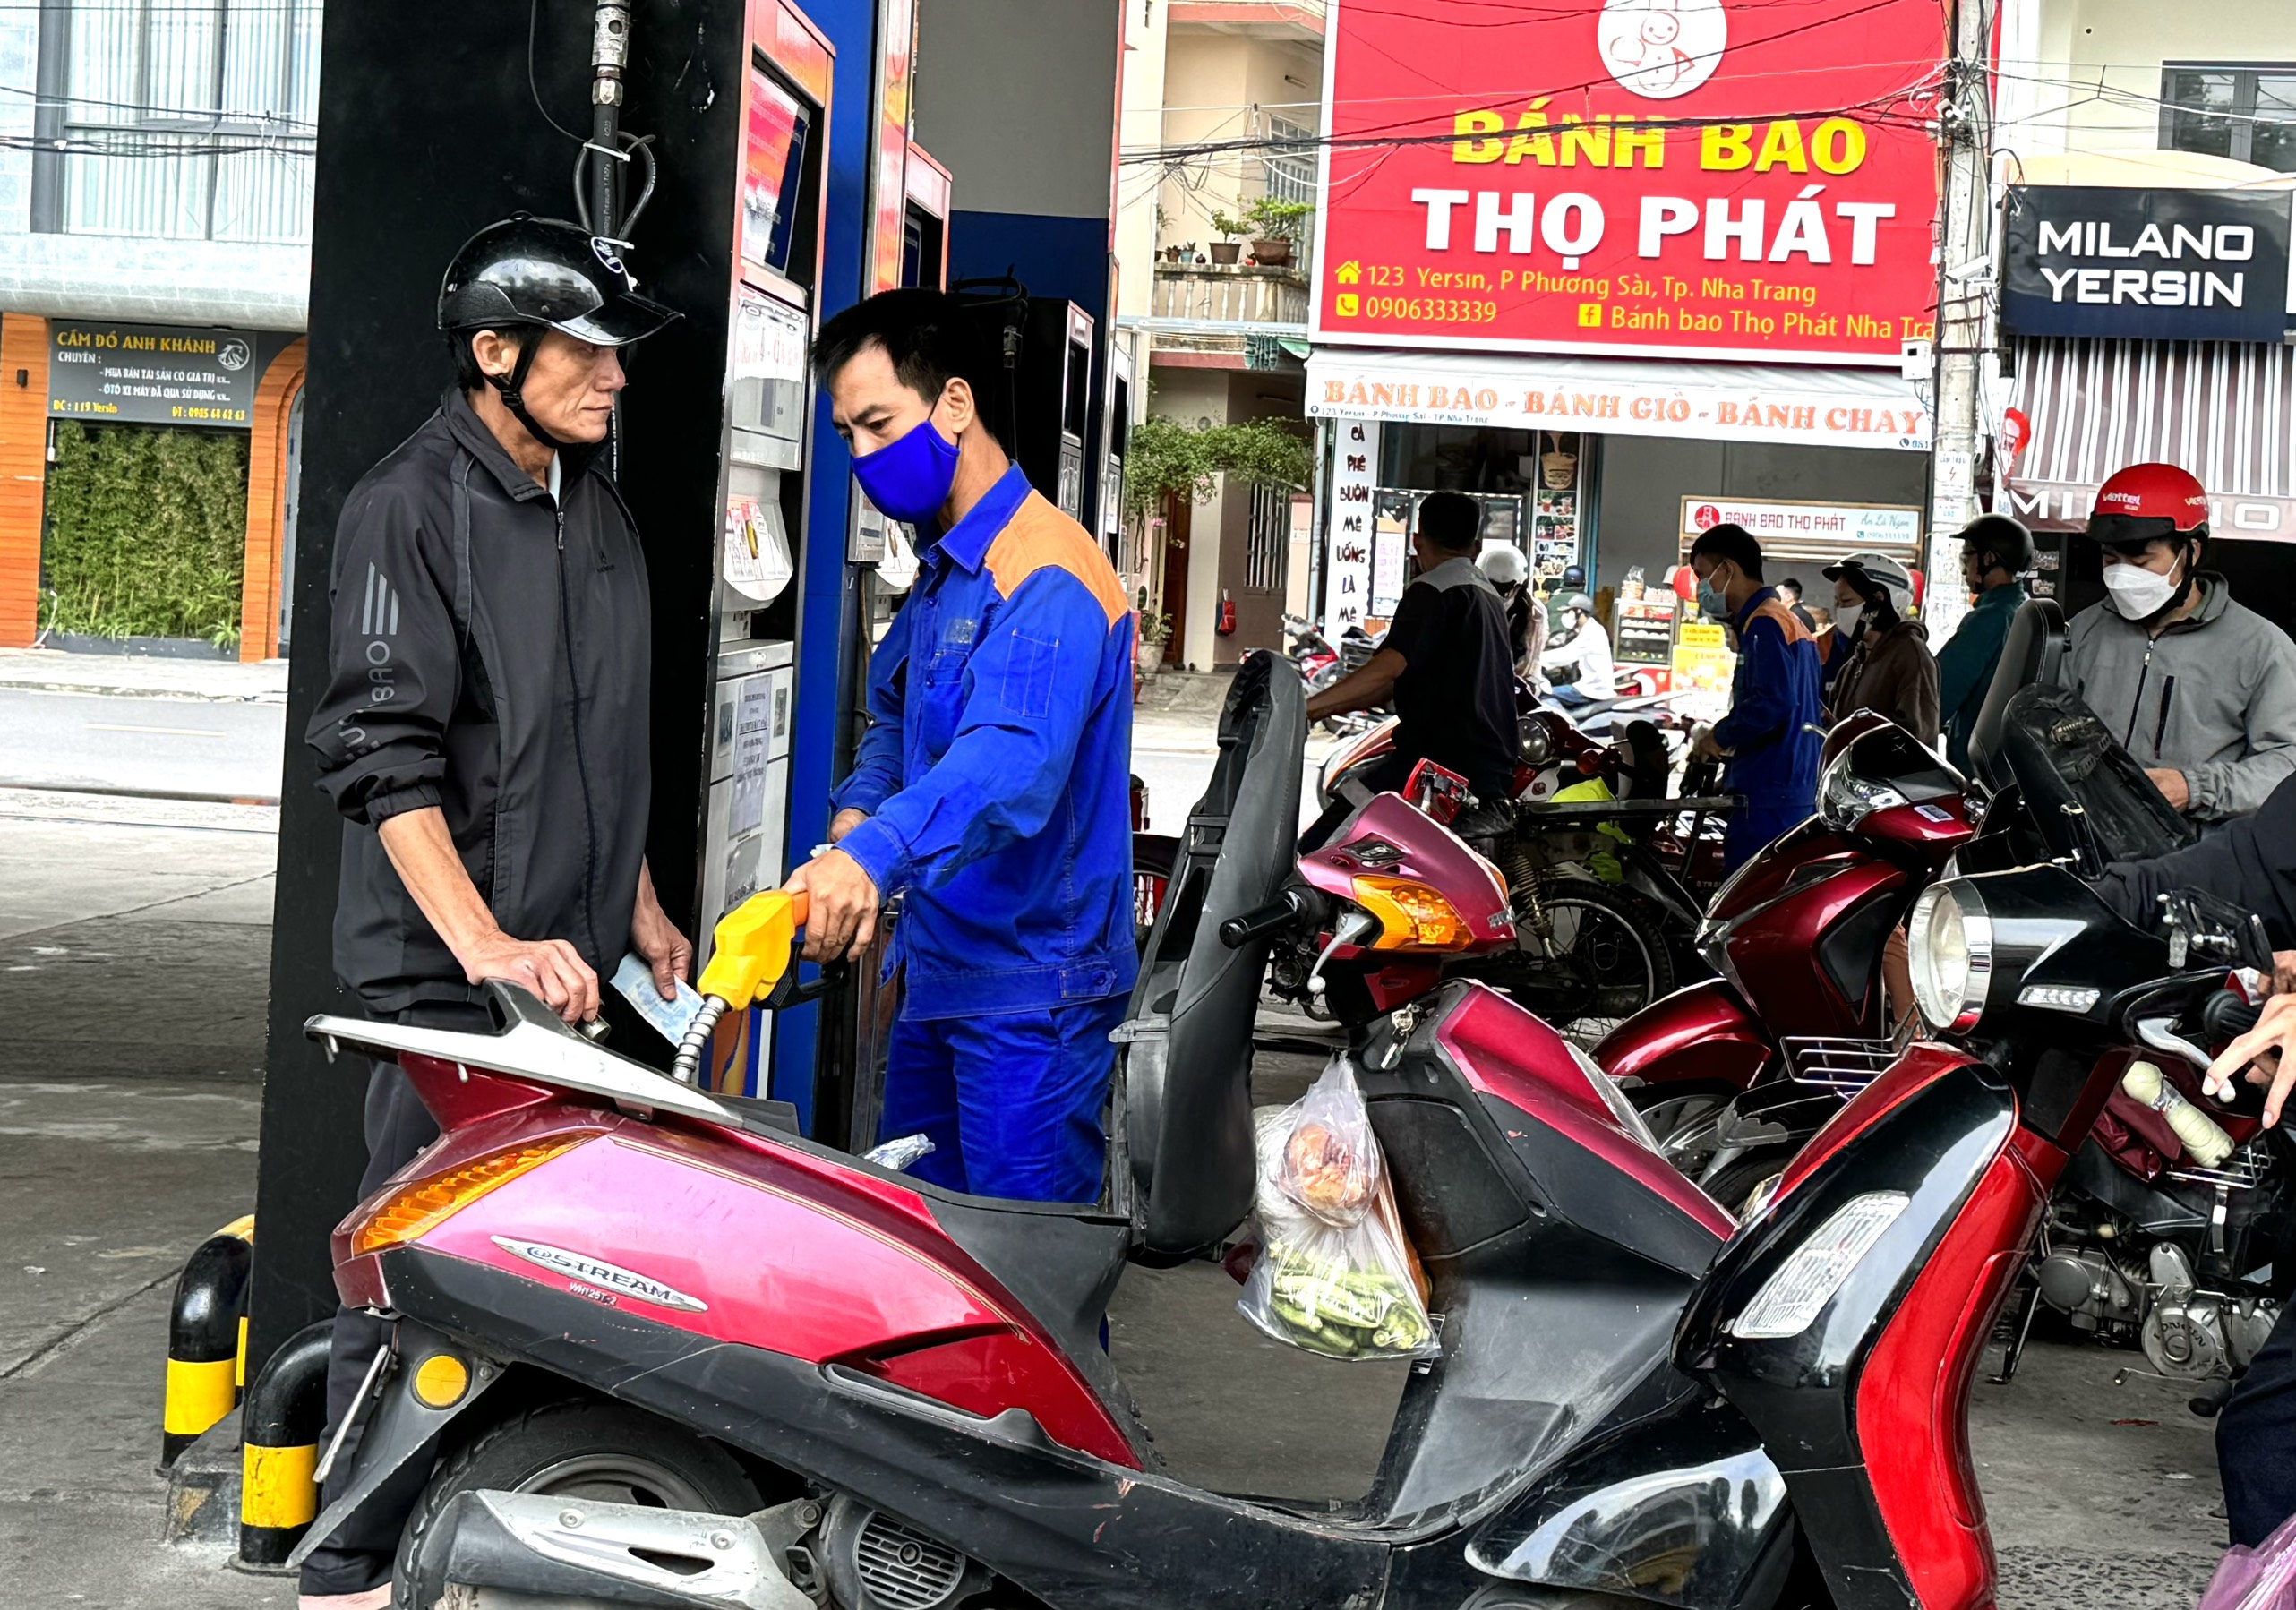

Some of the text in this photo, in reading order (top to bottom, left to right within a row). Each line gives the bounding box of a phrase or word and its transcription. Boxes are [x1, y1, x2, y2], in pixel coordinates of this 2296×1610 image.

[1452, 97, 1867, 175] BÁNH BAO
[1411, 184, 1896, 270] THỌ PHÁT
[2038, 221, 2253, 261] MILANO
[1367, 265, 1405, 287] 123
[1500, 270, 1514, 290] P
[1521, 270, 1609, 300] Phương
[1702, 278, 1744, 300] Nha
[1752, 279, 1816, 306] Trang
[2040, 269, 2243, 307] YERSIN
[1366, 296, 1497, 323] 0906333339
[1612, 304, 1671, 330] Bánh
[1679, 309, 1723, 334] bao
[1730, 311, 1775, 340] Thọ
[1783, 312, 1838, 338] Phát
[1846, 316, 1892, 338] Nha
[1900, 317, 1934, 339] Tra
[122, 335, 156, 351] ANH
[159, 336, 216, 354] KHÁNH
[104, 367, 122, 378] MUA
[1324, 375, 1420, 409] BÁNH
[1429, 386, 1498, 411] BAO
[1523, 385, 1621, 418] BÁNH
[1717, 397, 1814, 430] BÁNH
[1823, 407, 1924, 434] CHAY
[1347, 454, 1366, 472] PHÊ
[1340, 484, 1369, 502] BUÔN
[1343, 515, 1362, 533] MÊ
[1760, 513, 1784, 528] BAO
[1787, 515, 1811, 533] THỌ
[1814, 513, 1846, 531] PHÁT
[1342, 575, 1356, 594] LÀ
[1338, 606, 1357, 623] MÊ
